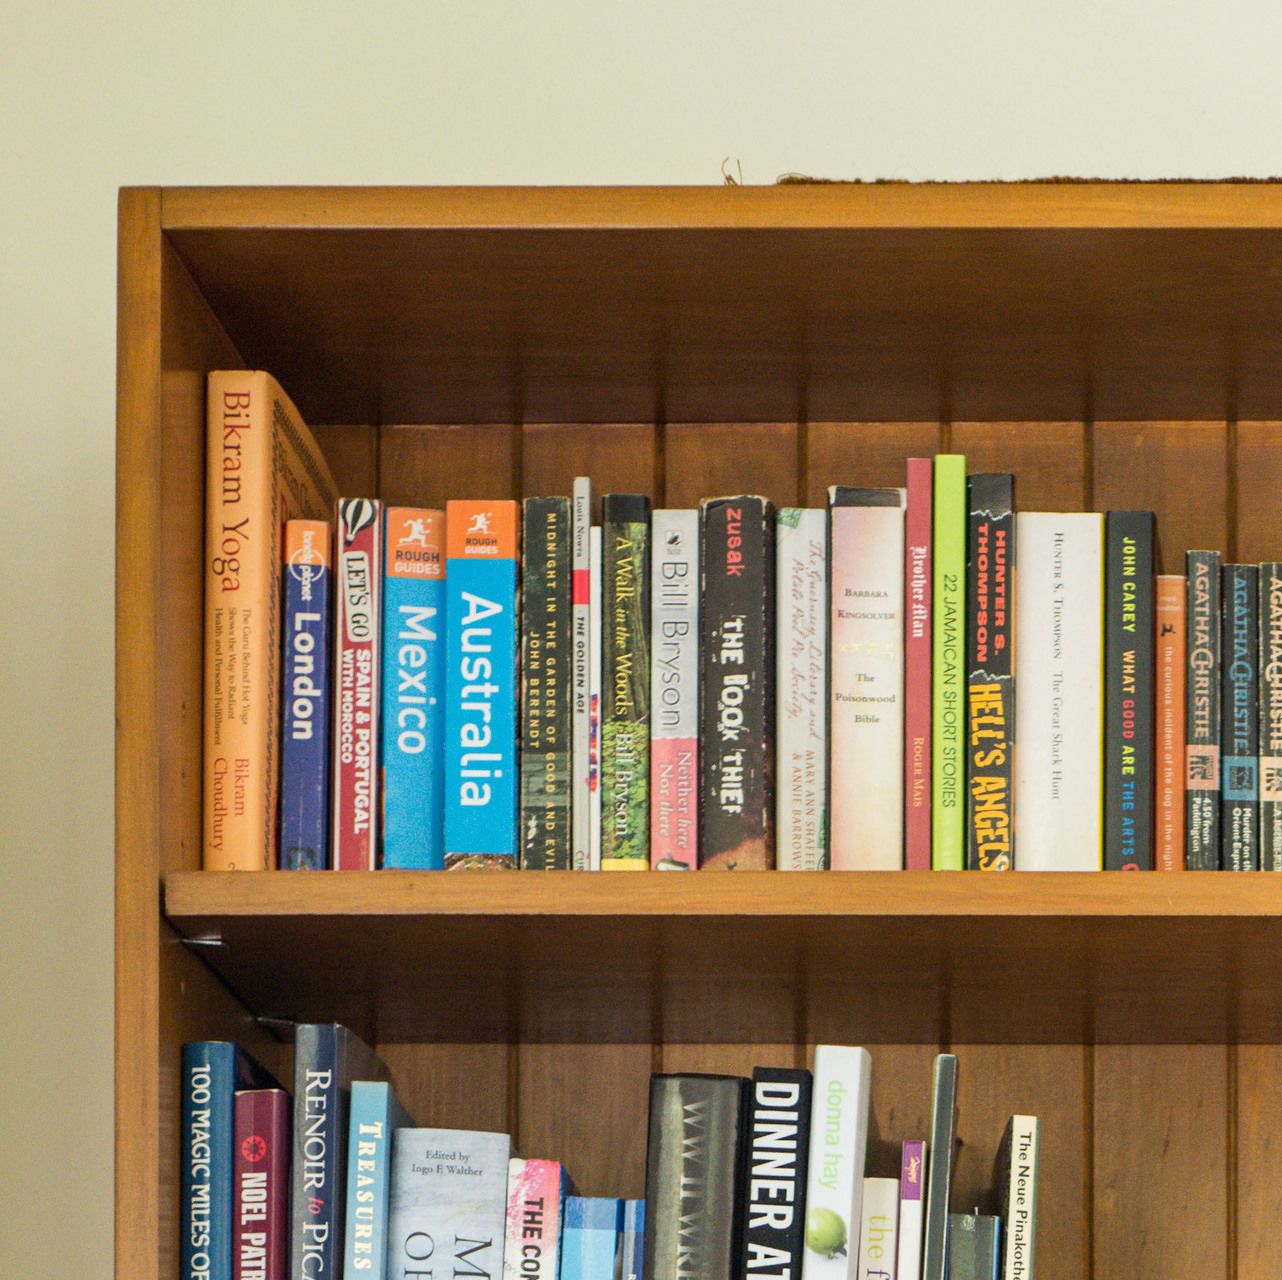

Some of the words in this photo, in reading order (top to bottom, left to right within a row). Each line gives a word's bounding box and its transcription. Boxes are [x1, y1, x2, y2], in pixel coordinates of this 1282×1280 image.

[222, 390, 251, 507] Bikram
[212, 518, 250, 593] Yoga
[395, 562, 441, 573] GUIDES
[396, 551, 440, 560] ROUGH
[546, 514, 556, 589] MIDNIGHT
[1123, 537, 1135, 576] JOHN
[346, 557, 368, 605] LET'S
[661, 561, 688, 606] Bill
[943, 574, 956, 593] 22
[352, 612, 367, 638] GO
[547, 598, 555, 613] IN
[577, 616, 585, 636] THE
[1123, 583, 1135, 633] CAREY
[547, 622, 556, 648] THE
[943, 597, 956, 685] JAMAICAN
[292, 612, 320, 740] London
[342, 649, 352, 687] WITH
[355, 649, 369, 708] SPAIN
[397, 605, 436, 754] Mexico
[576, 641, 585, 688] GOLDEN
[658, 621, 689, 727] Bryson
[1123, 650, 1135, 693] WHAT
[460, 592, 503, 806] Australia
[546, 658, 556, 718] GARDEN
[576, 693, 584, 714] AGE
[341, 690, 353, 763] MOROCCO
[355, 711, 368, 724] &
[547, 727, 556, 744] OF
[943, 691, 956, 743] SHORT
[1123, 700, 1135, 738] GOOD
[355, 728, 370, 834] PORTUGAL
[546, 753, 555, 793] GOOD
[943, 747, 956, 808] STORIES
[1122, 746, 1135, 774] ARE
[209, 757, 228, 852] Choudhury
[234, 758, 249, 817] Bikram
[1122, 782, 1134, 810] THE
[545, 801, 555, 831] AND
[1122, 817, 1134, 855] ARTS
[545, 839, 554, 871] EVIL
[191, 1064, 211, 1103] 100
[191, 1109, 210, 1177] MAGIC
[304, 1069, 331, 1192] RENOIR
[1019, 1132, 1031, 1161] The
[749, 1081, 800, 1229] DINNER
[241, 1172, 267, 1225] NOEL
[307, 1196, 324, 1214] to
[1017, 1165, 1030, 1205] Neue
[191, 1184, 210, 1246] MILES
[523, 1198, 543, 1239] THE
